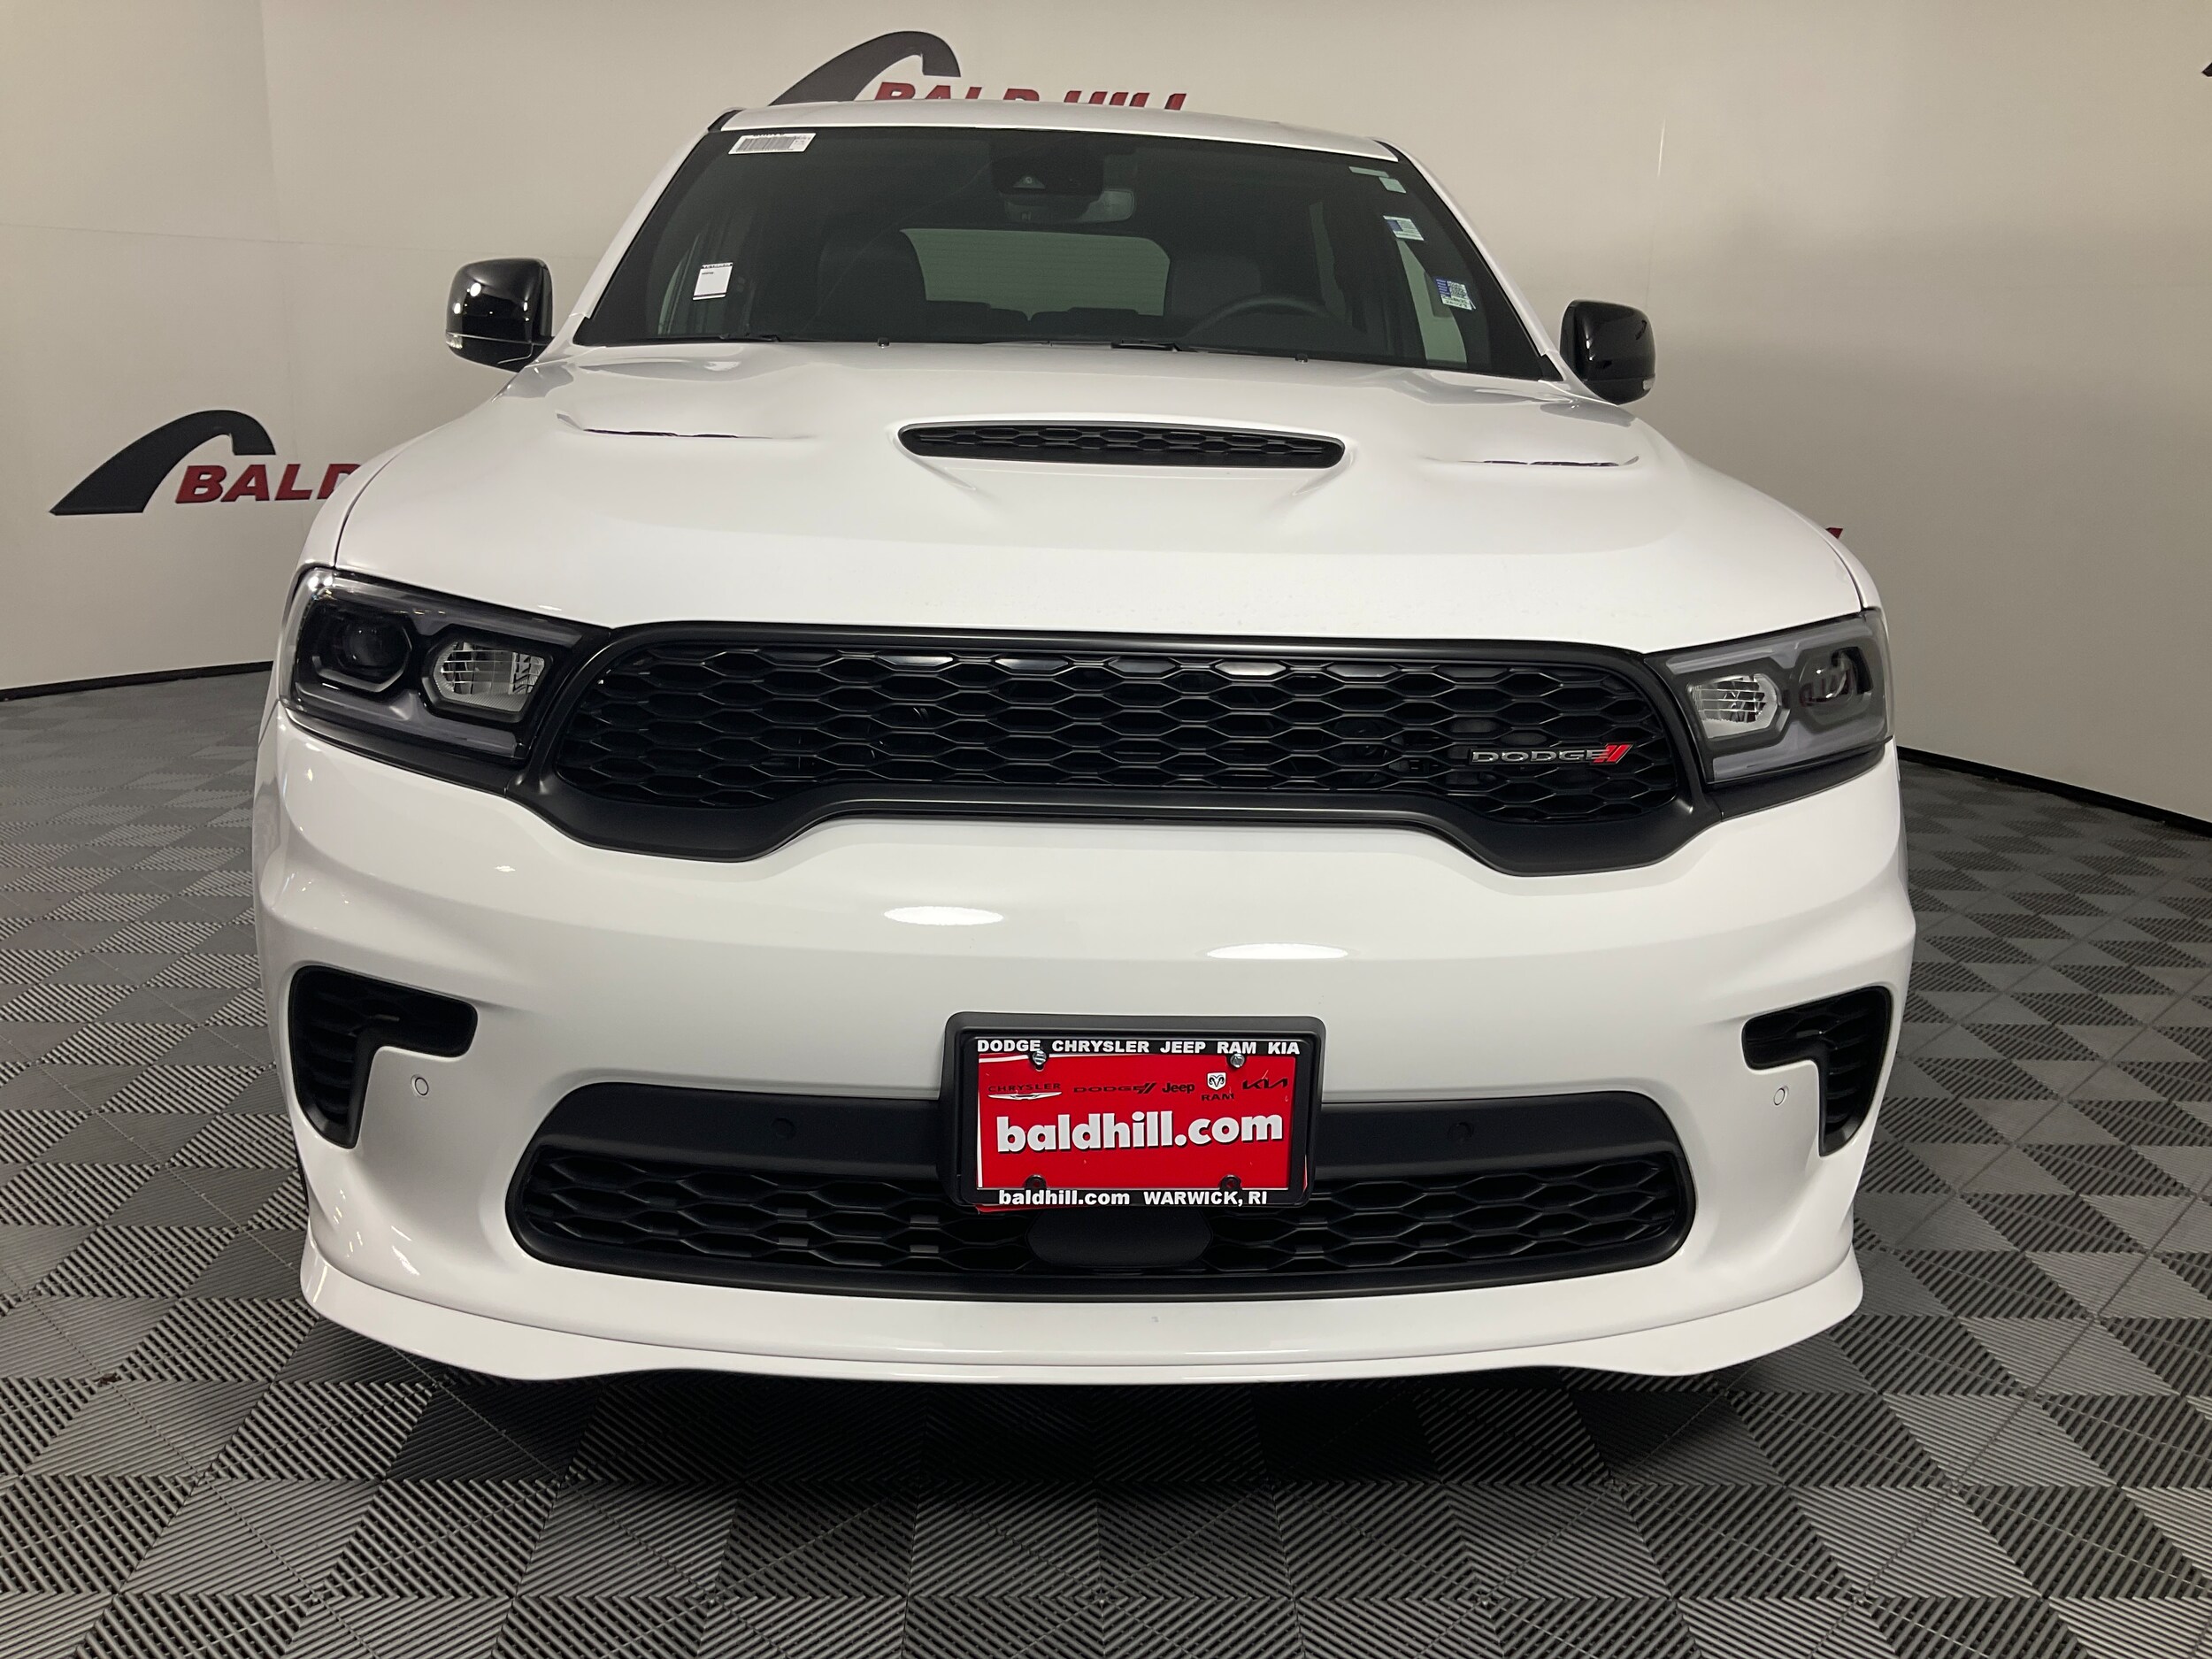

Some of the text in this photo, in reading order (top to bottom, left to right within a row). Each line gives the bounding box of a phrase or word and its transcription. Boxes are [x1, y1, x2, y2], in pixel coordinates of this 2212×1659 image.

[1472, 749, 1609, 763] DODGE
[977, 1039, 1301, 1055] DODGE CHRYSLER JEEP RAM KIA
[987, 1082, 1062, 1093] CHRYSLER
[1072, 1085, 1147, 1094] DODGE
[1161, 1082, 1195, 1094] Jeep
[1201, 1093, 1235, 1102] RAM
[996, 1110, 1284, 1153] baldhill.com
[998, 1190, 1268, 1208] baldhill.com WARWICK, RI
